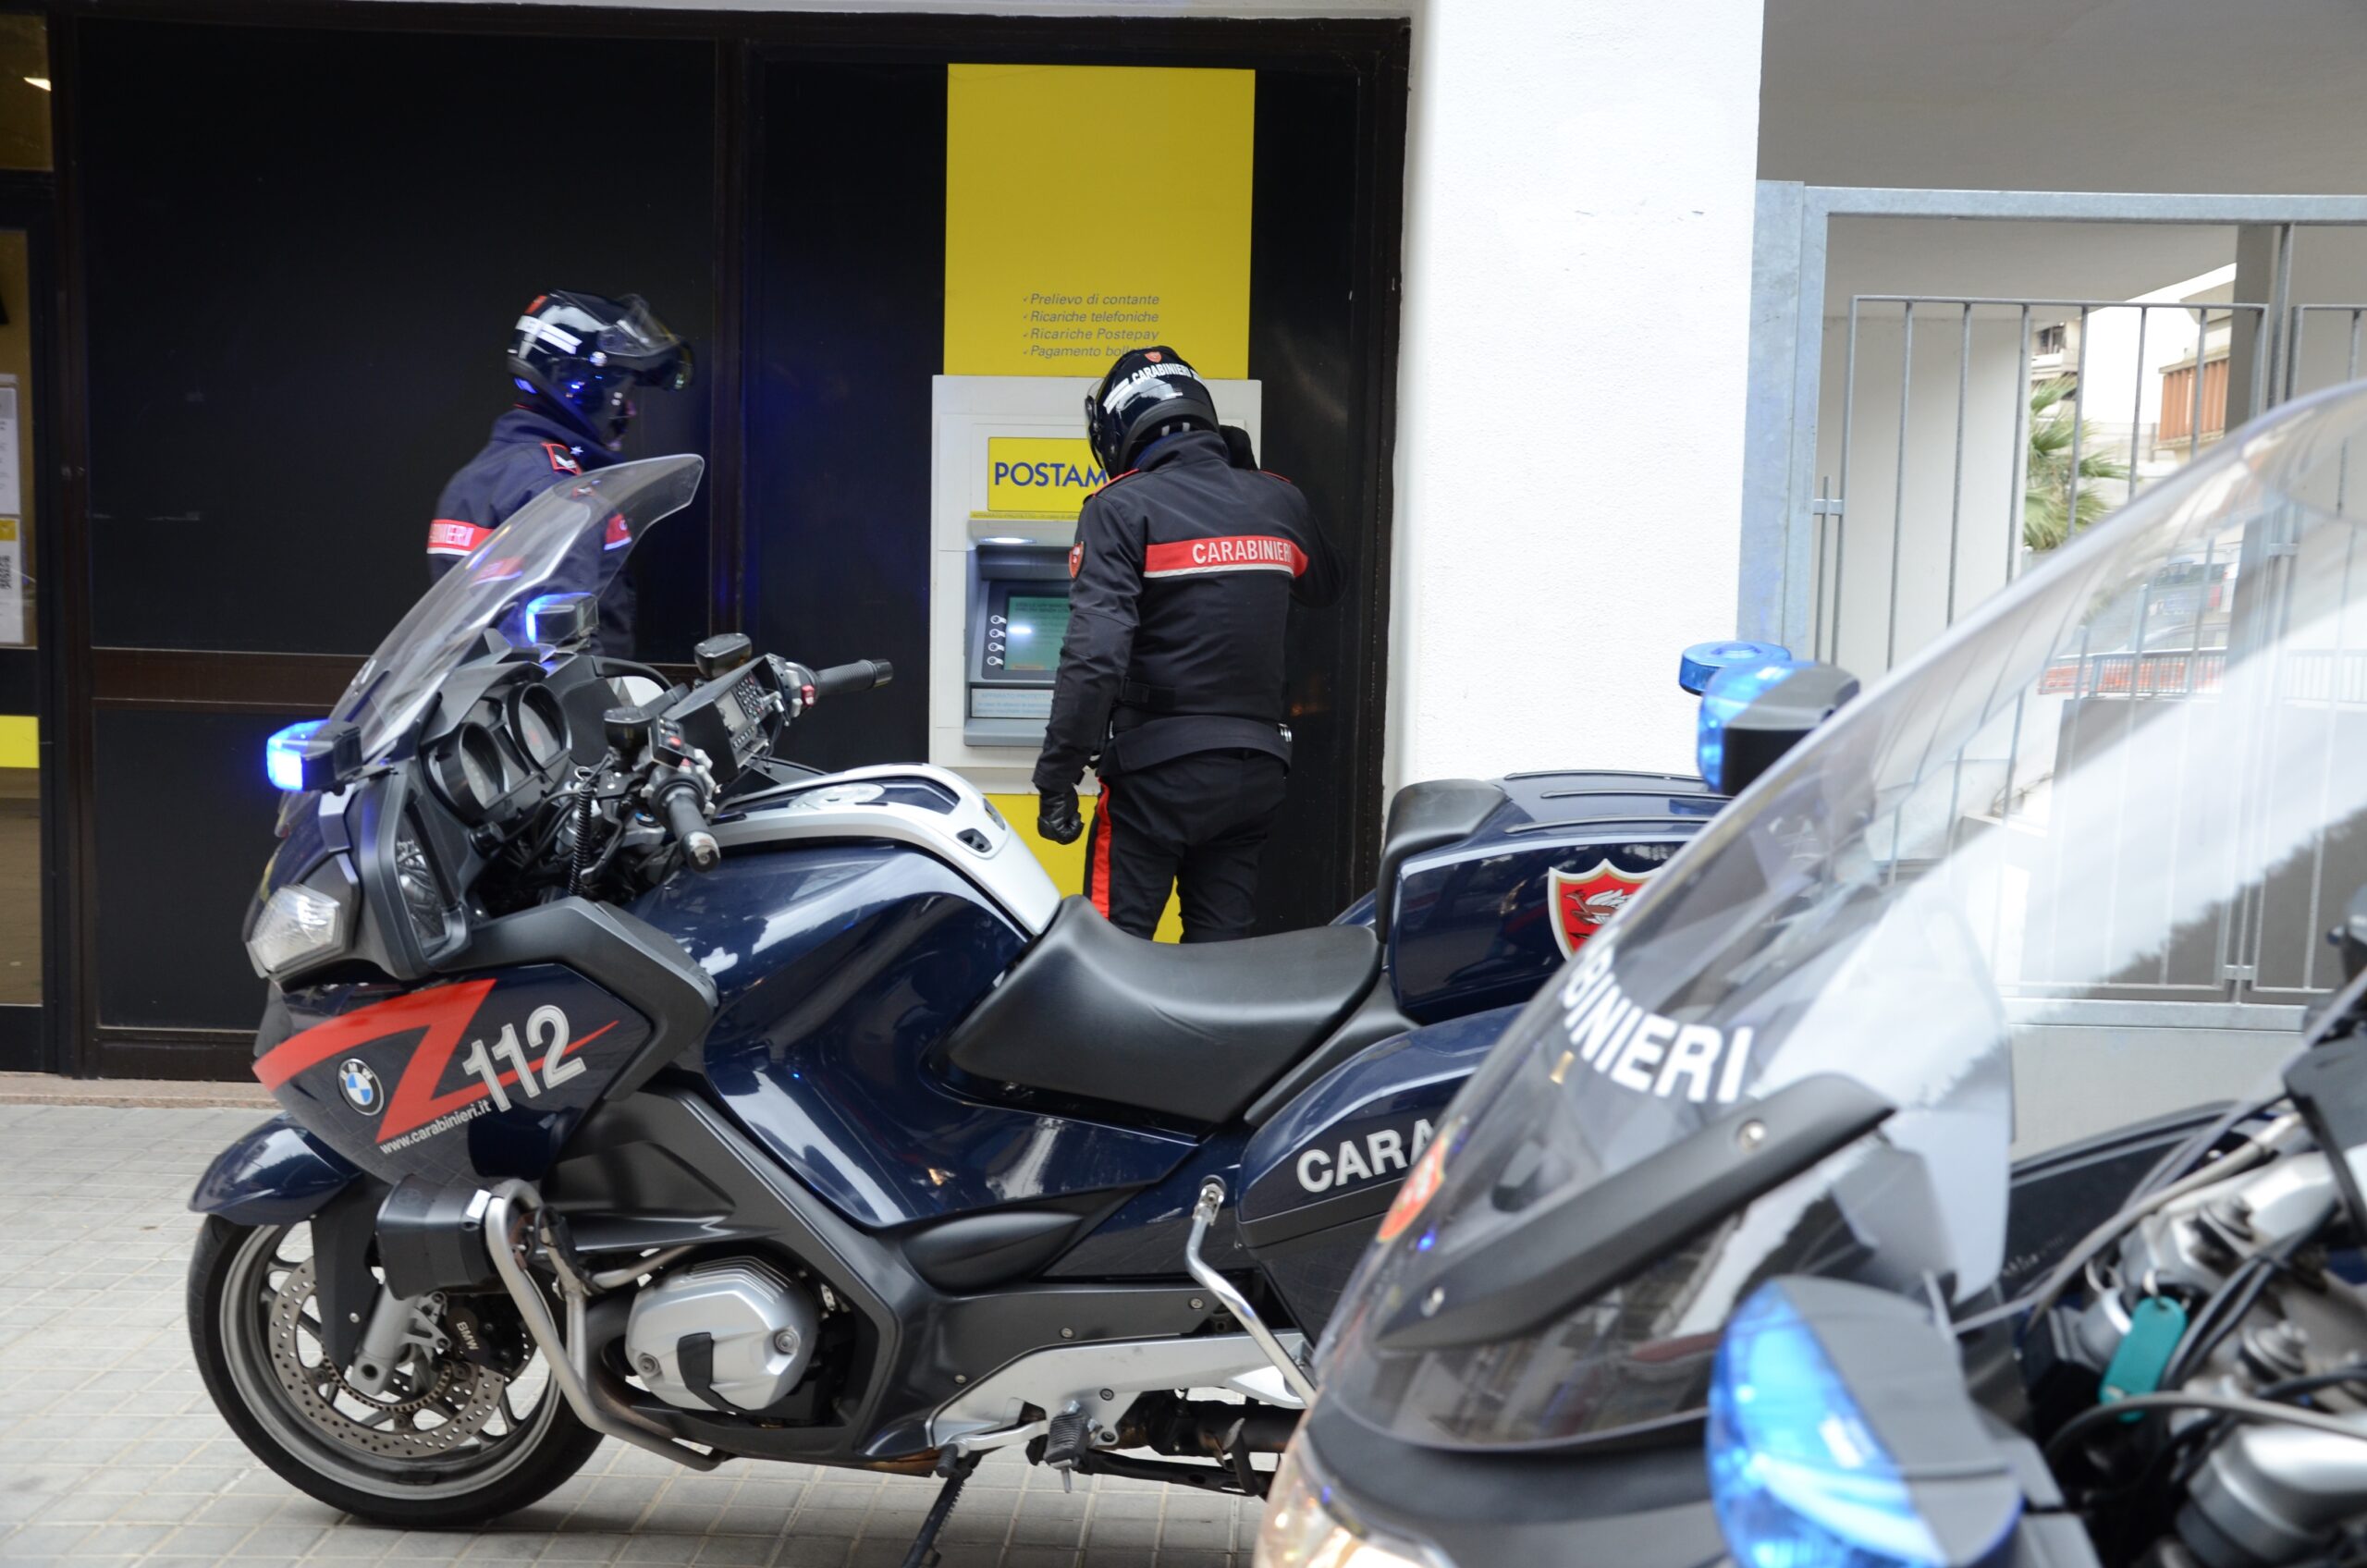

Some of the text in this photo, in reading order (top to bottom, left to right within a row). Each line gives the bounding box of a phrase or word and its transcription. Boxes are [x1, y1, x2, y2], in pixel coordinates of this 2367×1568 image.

[1030, 293, 1159, 305] Prelievo di contante
[1030, 311, 1159, 323] Ricariche telefoniche
[1030, 328, 1159, 342] Ricariche Postepay
[1030, 345, 1101, 359] Pagamento
[462, 1004, 586, 1112] 112
[339, 1062, 374, 1081] BMW
[379, 1098, 492, 1155] www.carabinieri.it
[456, 1321, 480, 1350] BMW
